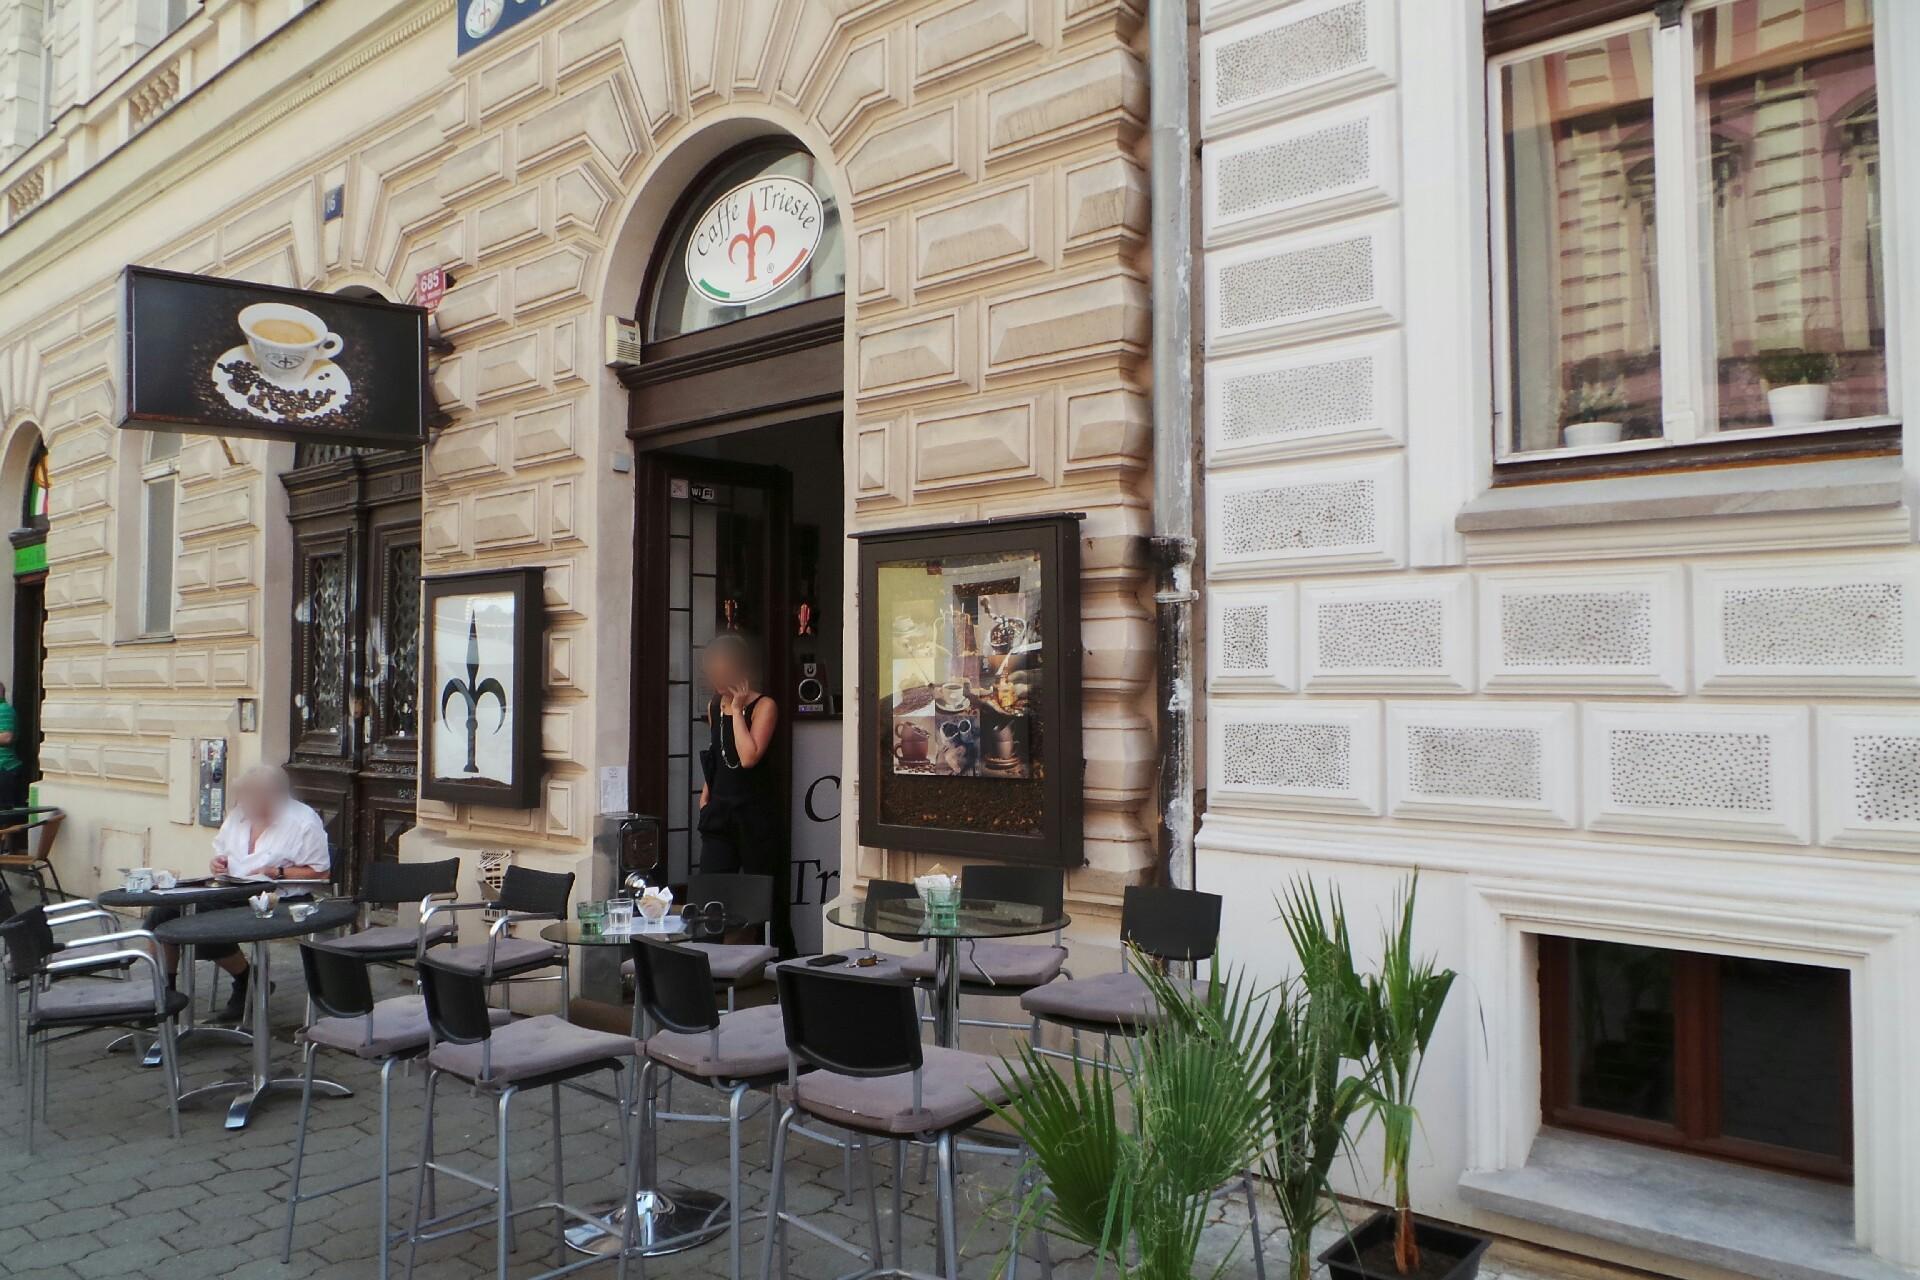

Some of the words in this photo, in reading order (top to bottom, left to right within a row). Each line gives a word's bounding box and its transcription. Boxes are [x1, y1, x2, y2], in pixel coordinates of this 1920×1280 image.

[760, 184, 815, 229] Trieste
[421, 270, 439, 292] 685
[790, 859, 841, 905] Tr
